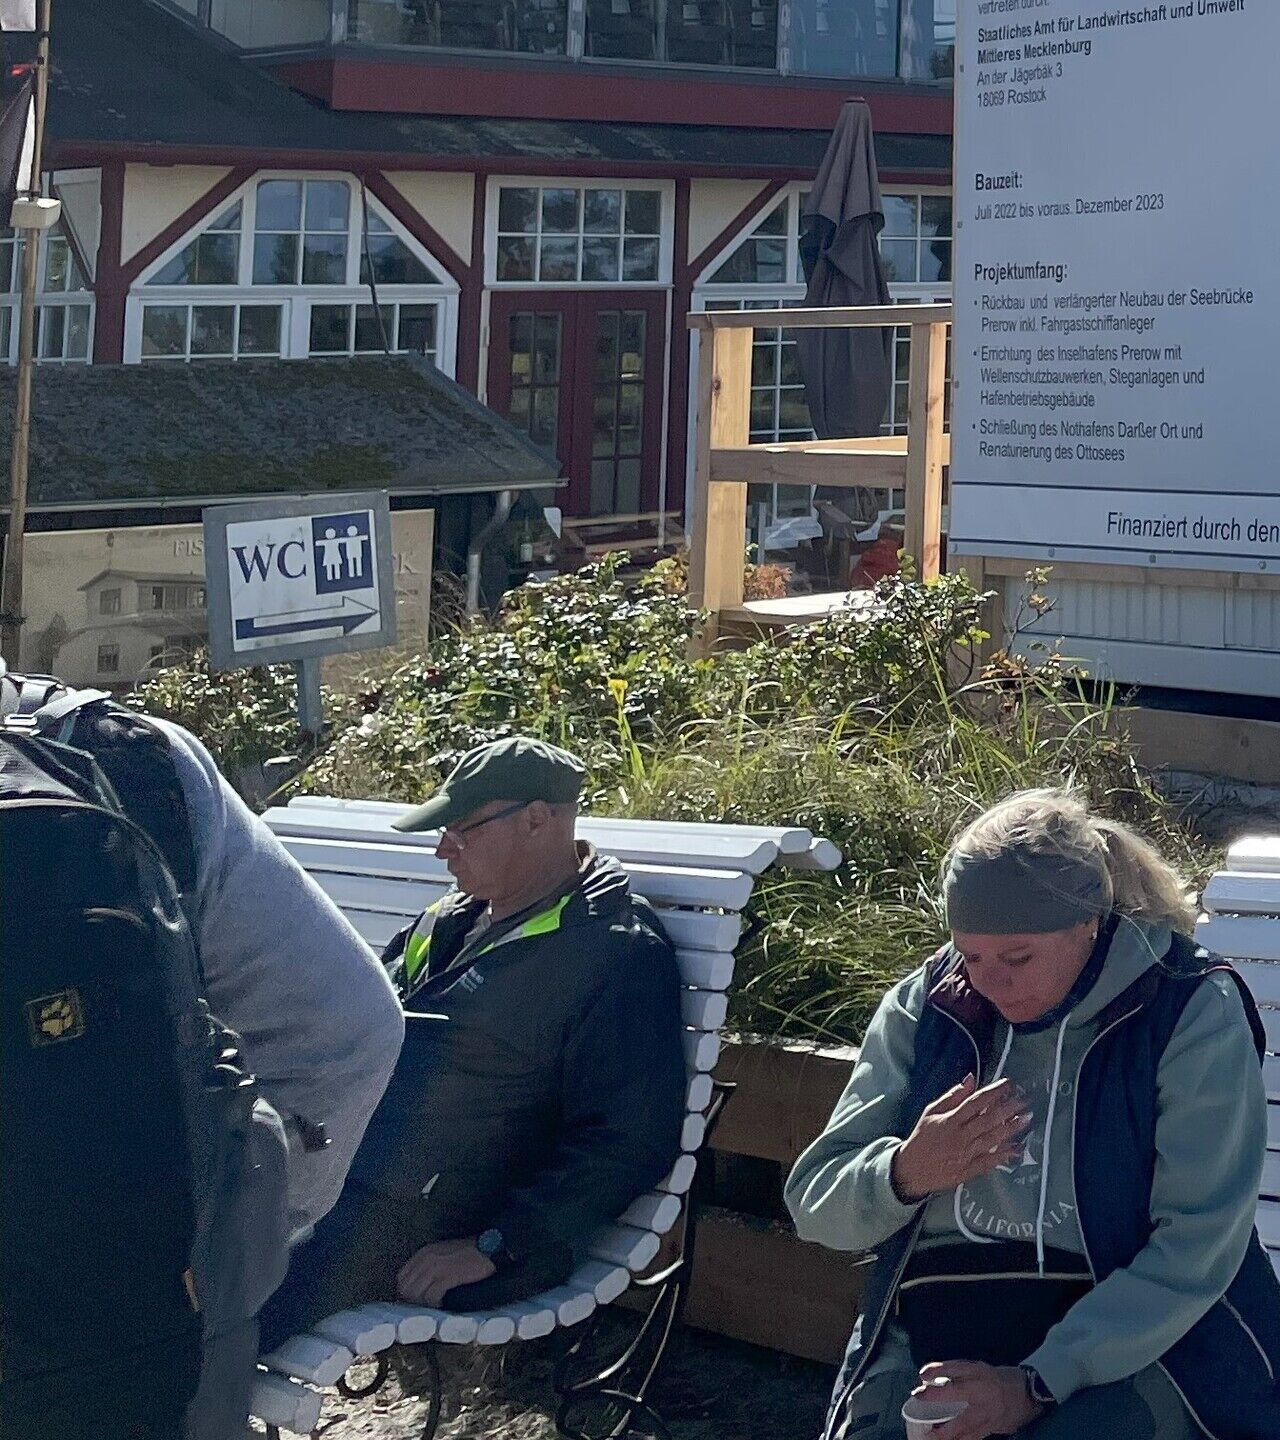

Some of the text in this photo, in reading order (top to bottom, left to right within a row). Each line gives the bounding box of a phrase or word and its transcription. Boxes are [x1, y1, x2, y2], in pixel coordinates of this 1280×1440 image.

[977, 23, 1033, 43] Staatliches
[1033, 18, 1055, 36] Amt
[1057, 16, 1075, 33] für
[1077, 4, 1168, 31] Landwirtschaft
[1170, 1, 1194, 19] und
[974, 204, 992, 221] Juli
[994, 202, 1017, 220] 2022
[1019, 202, 1035, 218] bis
[1075, 195, 1134, 215] Dezember
[1135, 193, 1165, 211] 2023
[981, 294, 1025, 311] Rückbau
[1029, 293, 1048, 310] und
[1119, 290, 1165, 308] Neubau
[1167, 289, 1188, 306] der
[1189, 287, 1254, 306] Seebrücke
[1109, 367, 1180, 389] Steganlagen
[1182, 367, 1205, 385] und
[1038, 419, 1059, 437] des
[1060, 420, 1115, 438] Nothafens
[1117, 421, 1157, 439] Darßer
[1159, 421, 1179, 439] Ort
[1181, 422, 1203, 440] und
[1107, 511, 1188, 539] Finanziert
[1192, 515, 1241, 541] durch
[1247, 518, 1280, 543] den
[230, 540, 308, 584] WC
